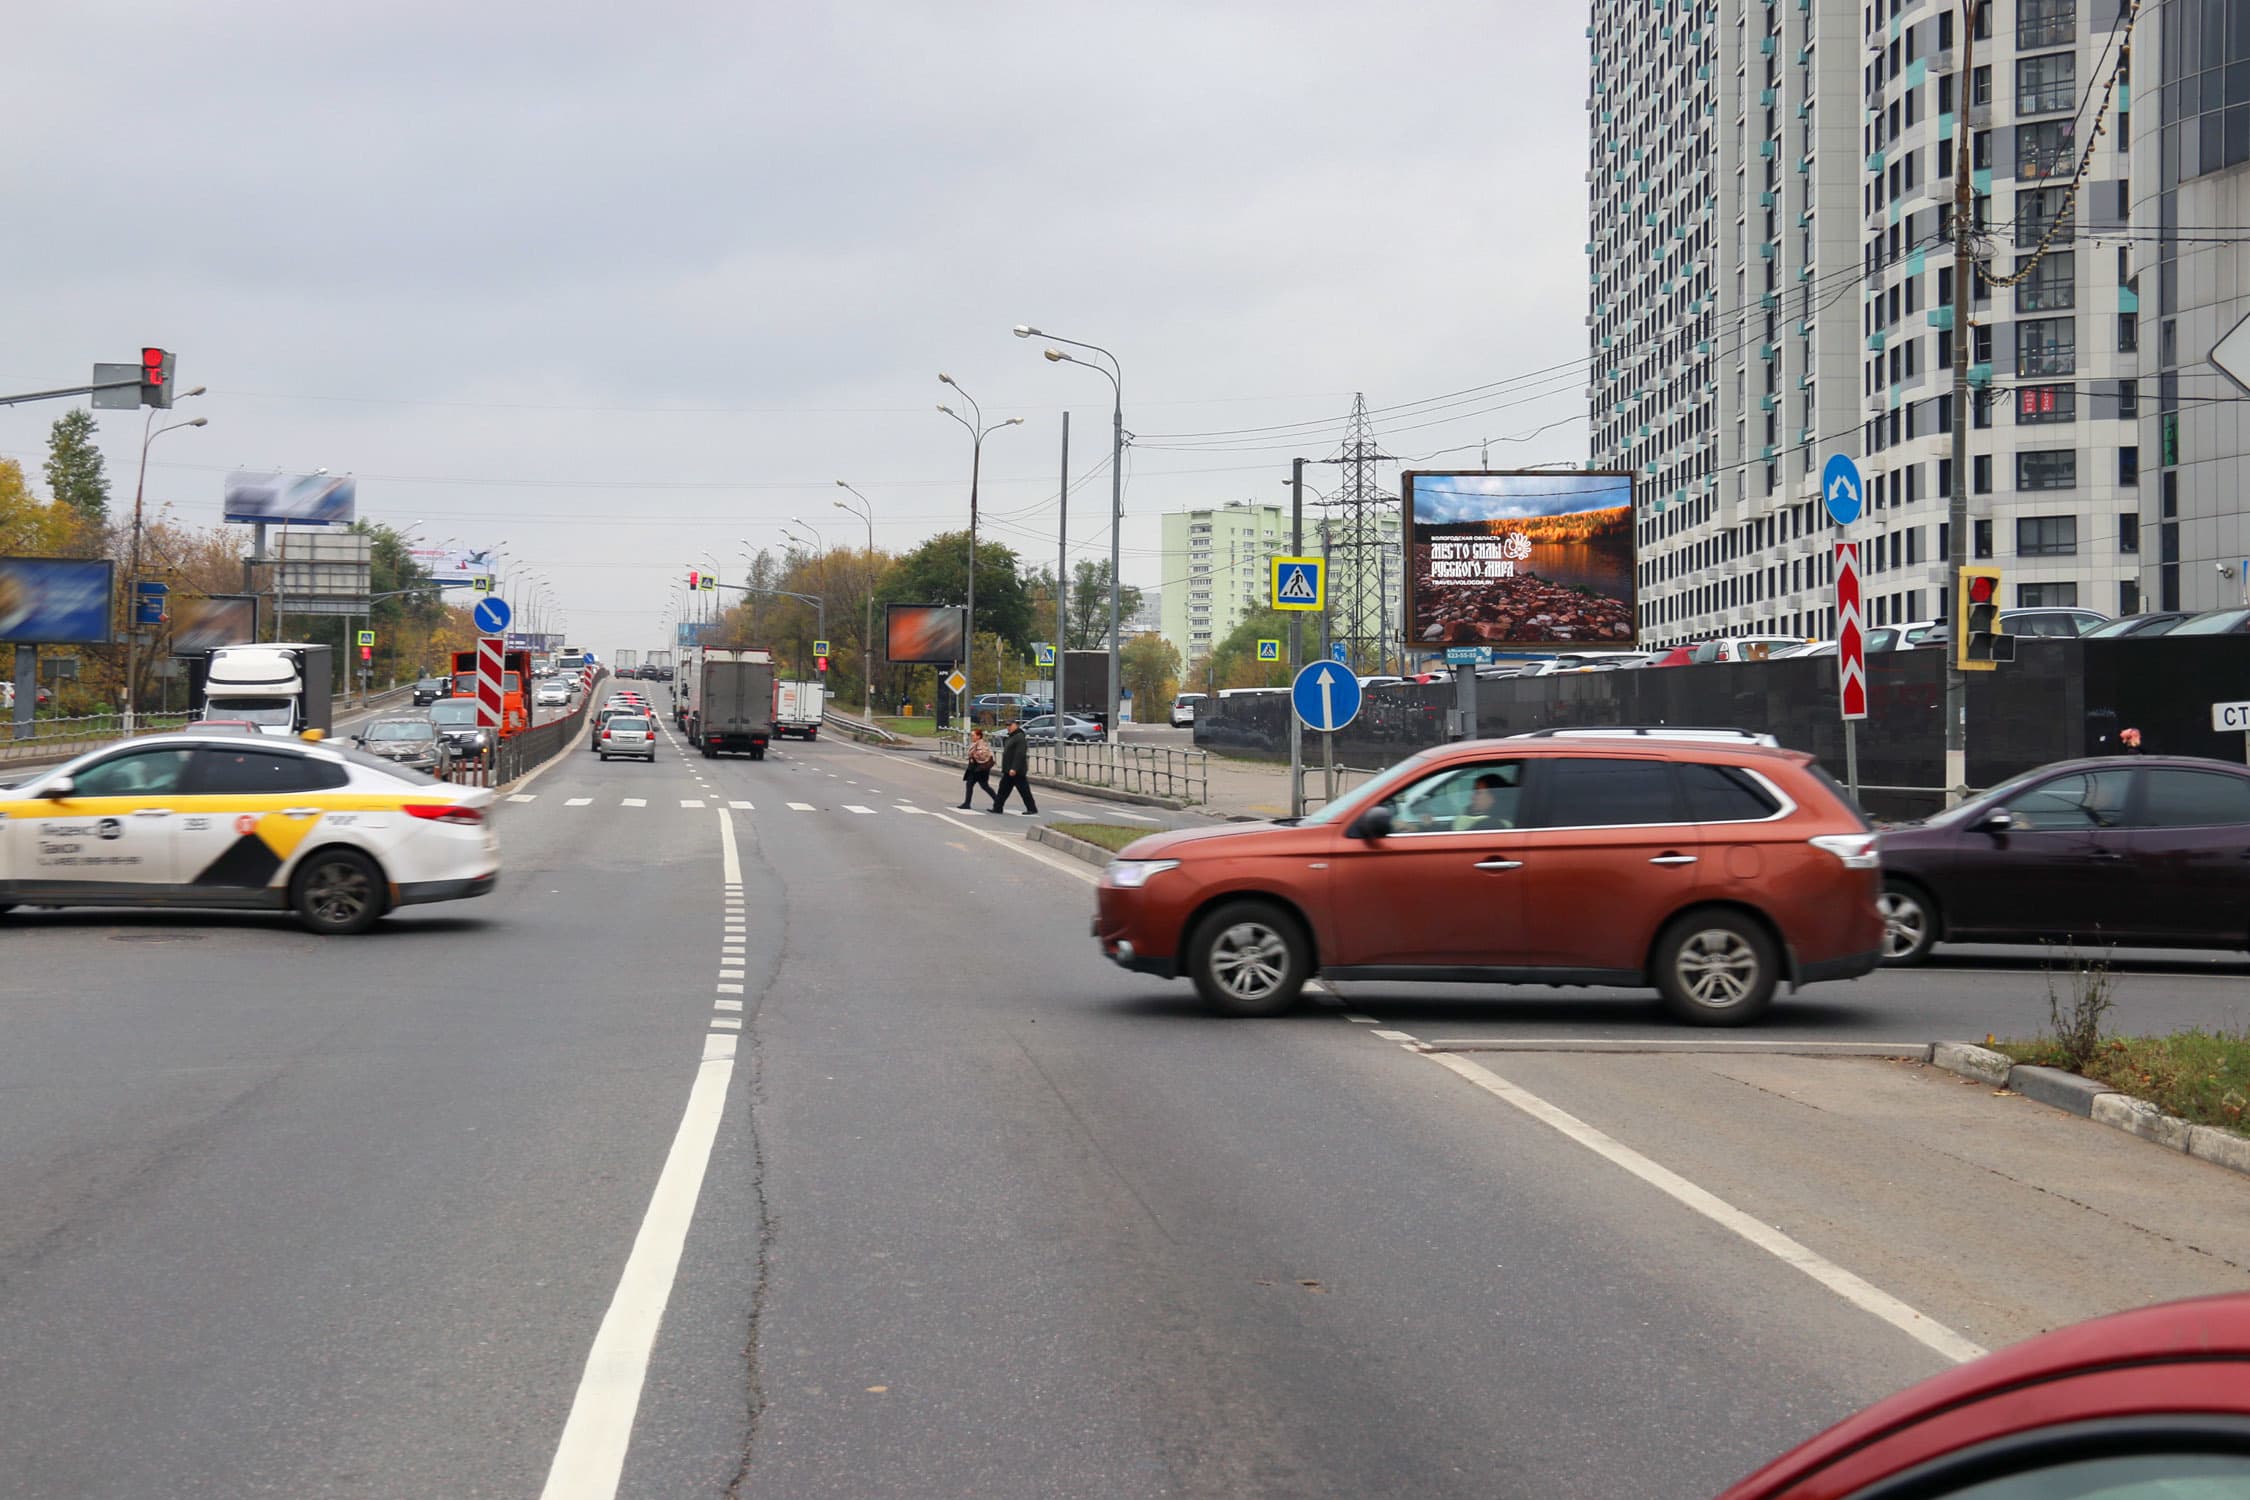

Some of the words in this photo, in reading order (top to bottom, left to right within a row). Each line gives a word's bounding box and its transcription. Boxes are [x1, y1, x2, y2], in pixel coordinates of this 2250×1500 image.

[1431, 542, 1470, 560] МЕСТО
[1472, 542, 1502, 560] СИЛЫ
[1431, 560, 1481, 578] РУССКОГО
[1484, 560, 1514, 578] МИРА
